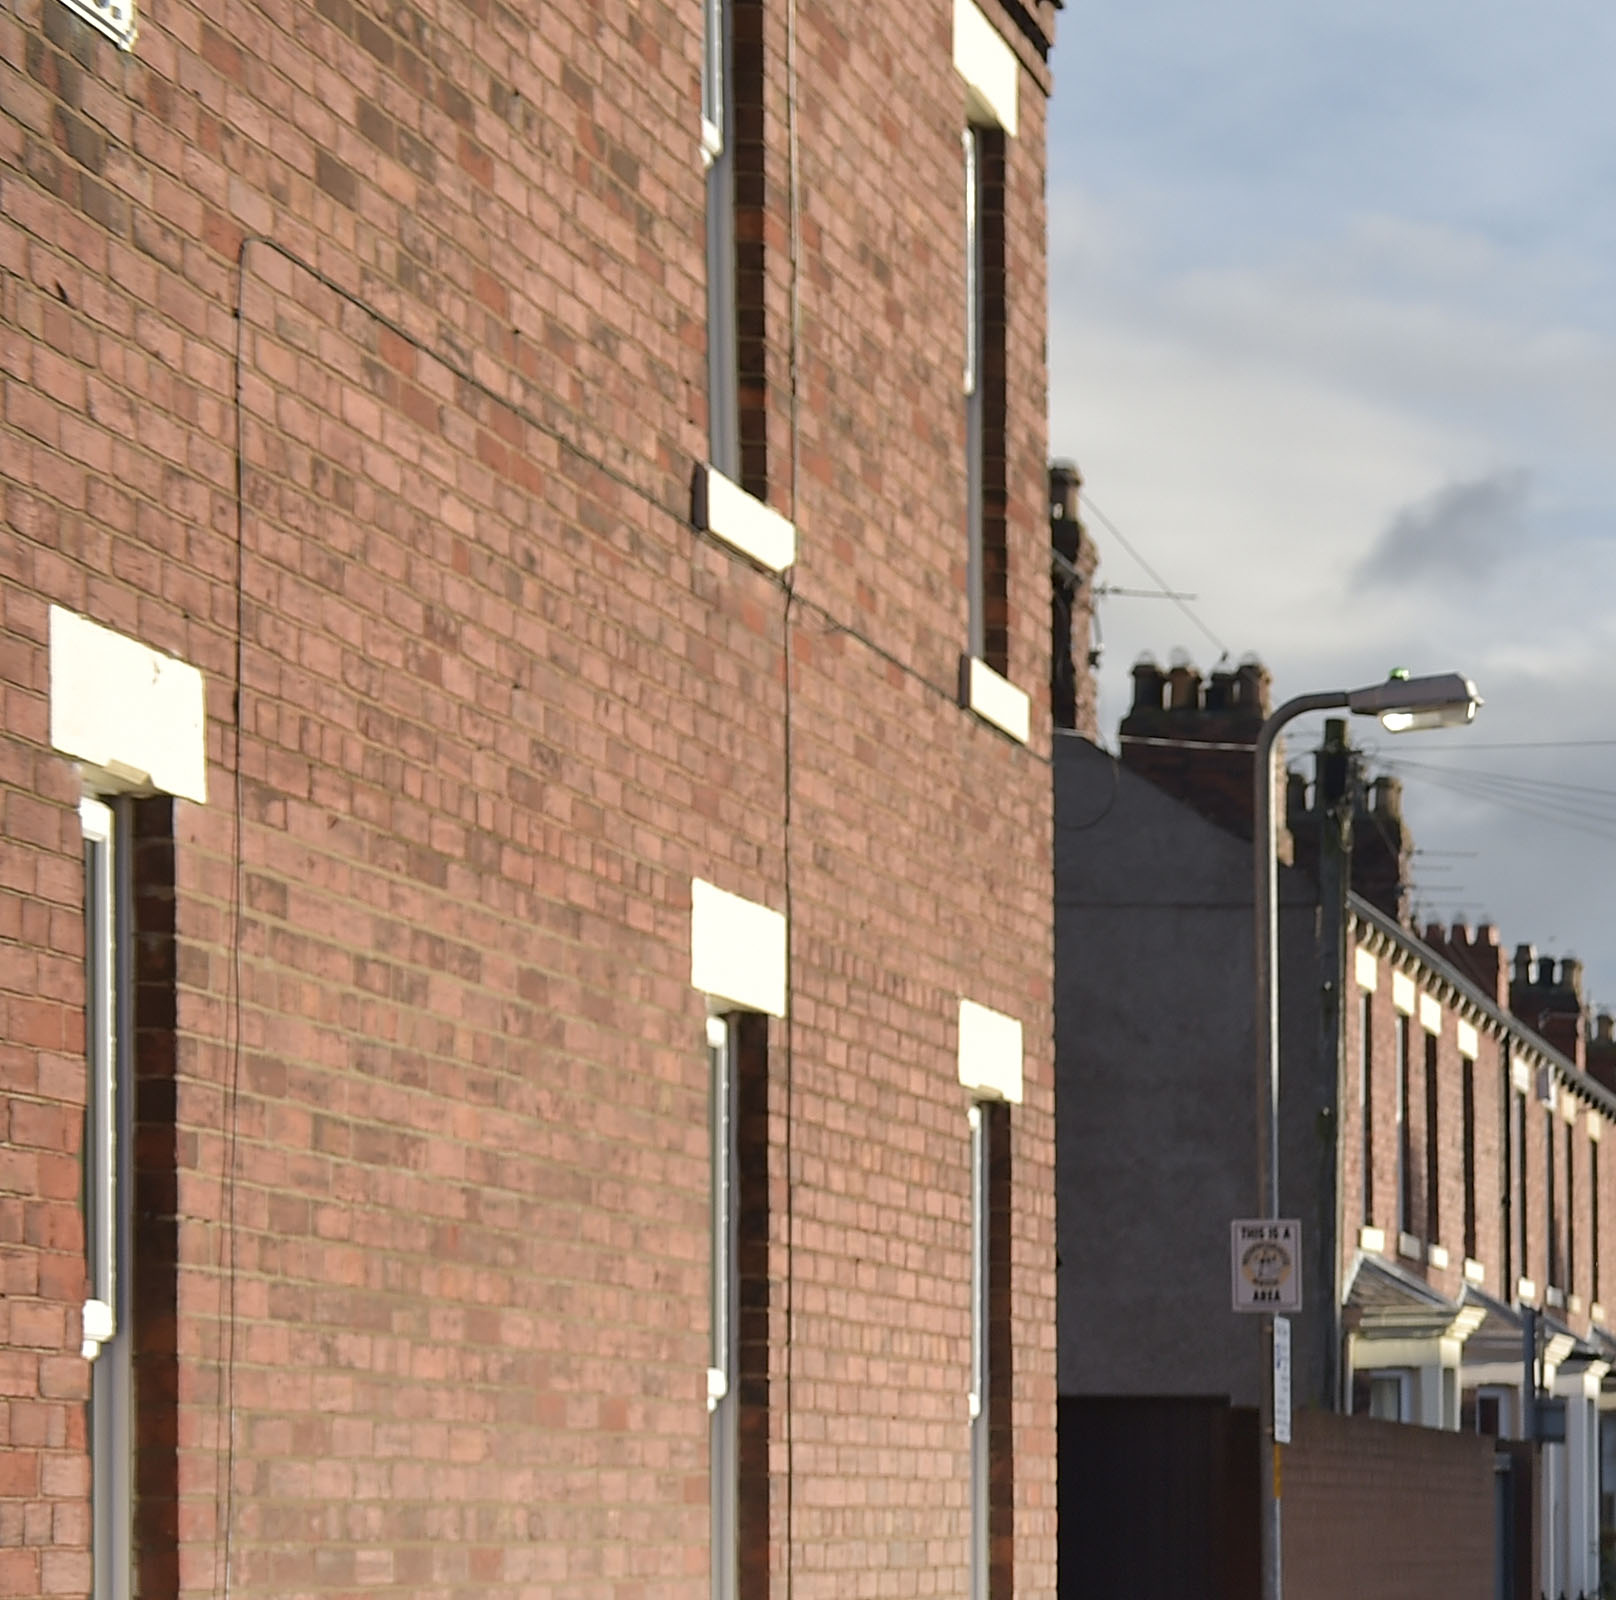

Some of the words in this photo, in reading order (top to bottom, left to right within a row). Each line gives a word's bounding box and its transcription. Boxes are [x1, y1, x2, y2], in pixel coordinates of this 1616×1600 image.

[1241, 1226, 1264, 1239] THIS
[1269, 1226, 1278, 1239] IS
[1284, 1226, 1291, 1239] A
[1253, 1290, 1280, 1301] AREA
